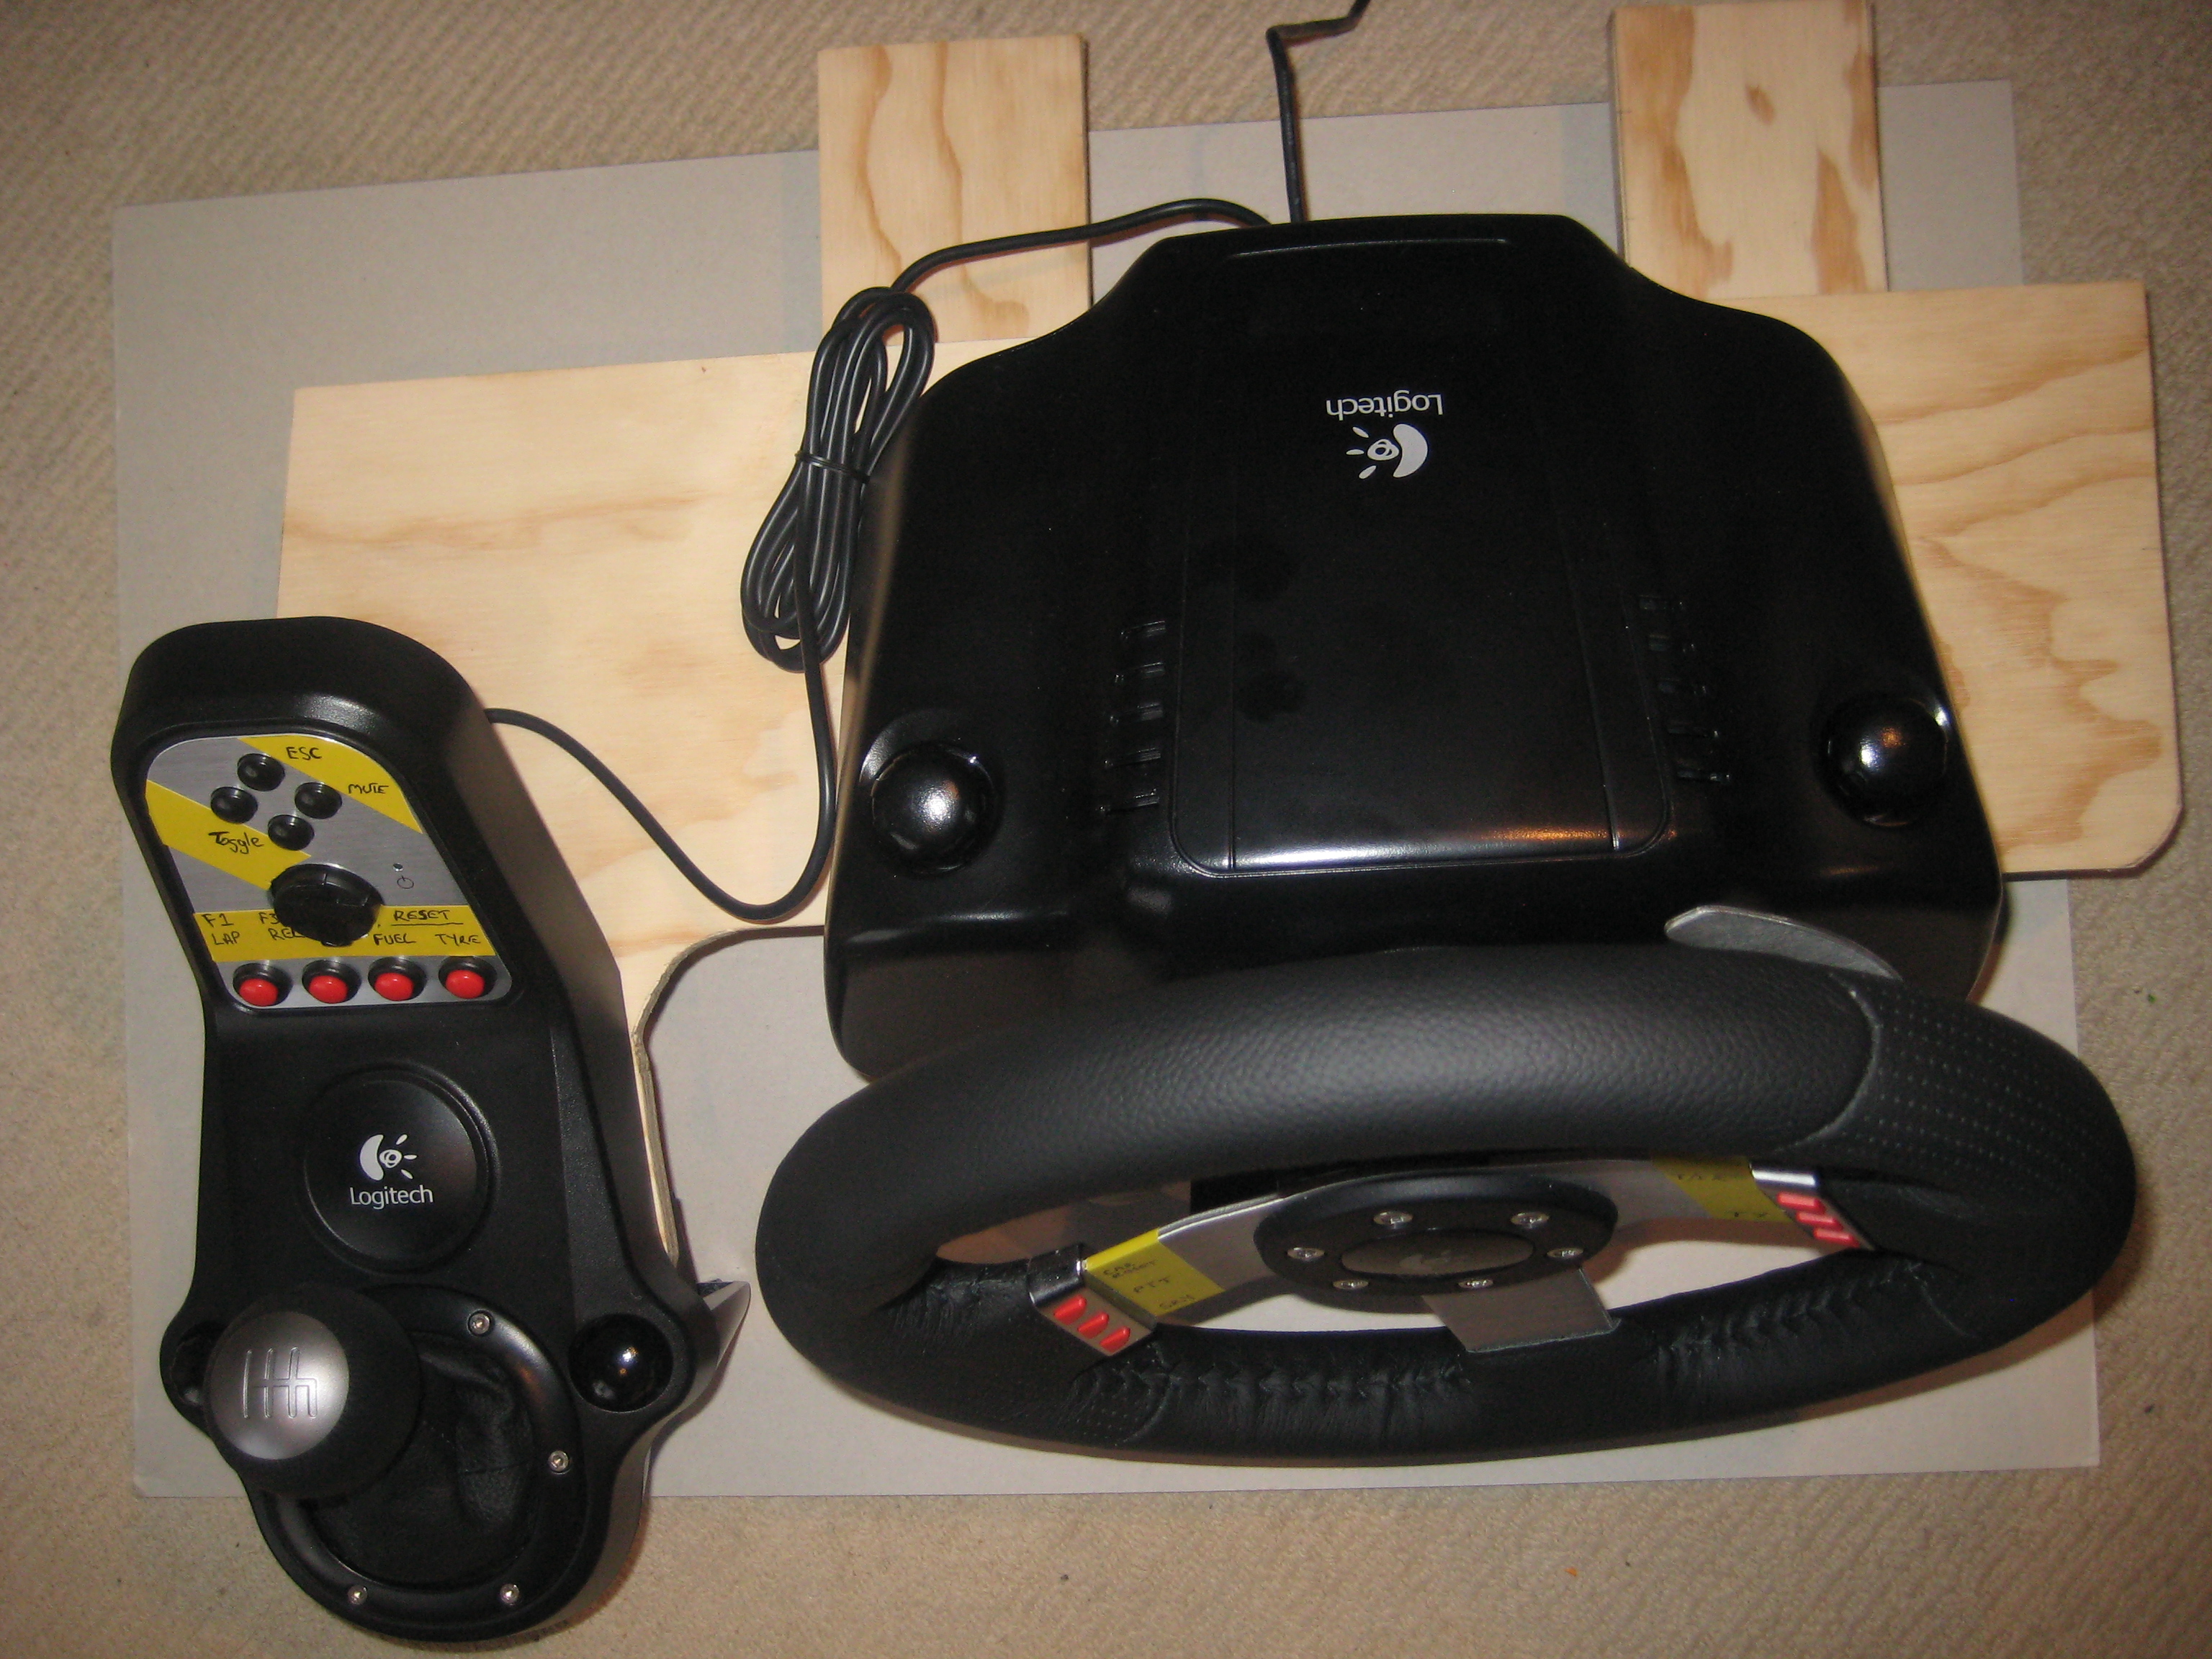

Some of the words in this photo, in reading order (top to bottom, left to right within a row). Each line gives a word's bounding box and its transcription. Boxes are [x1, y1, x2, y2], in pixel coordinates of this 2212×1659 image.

[1326, 390, 1444, 421] Logitech
[286, 747, 323, 760] ESC
[348, 782, 390, 794] MUTE
[208, 831, 265, 855] Toggle
[201, 913, 235, 928] F1
[393, 909, 451, 922] RESET
[211, 930, 240, 946] LAP
[372, 933, 417, 946] FUEL
[434, 933, 482, 947] TYRE
[349, 1184, 433, 1210] Logitech
